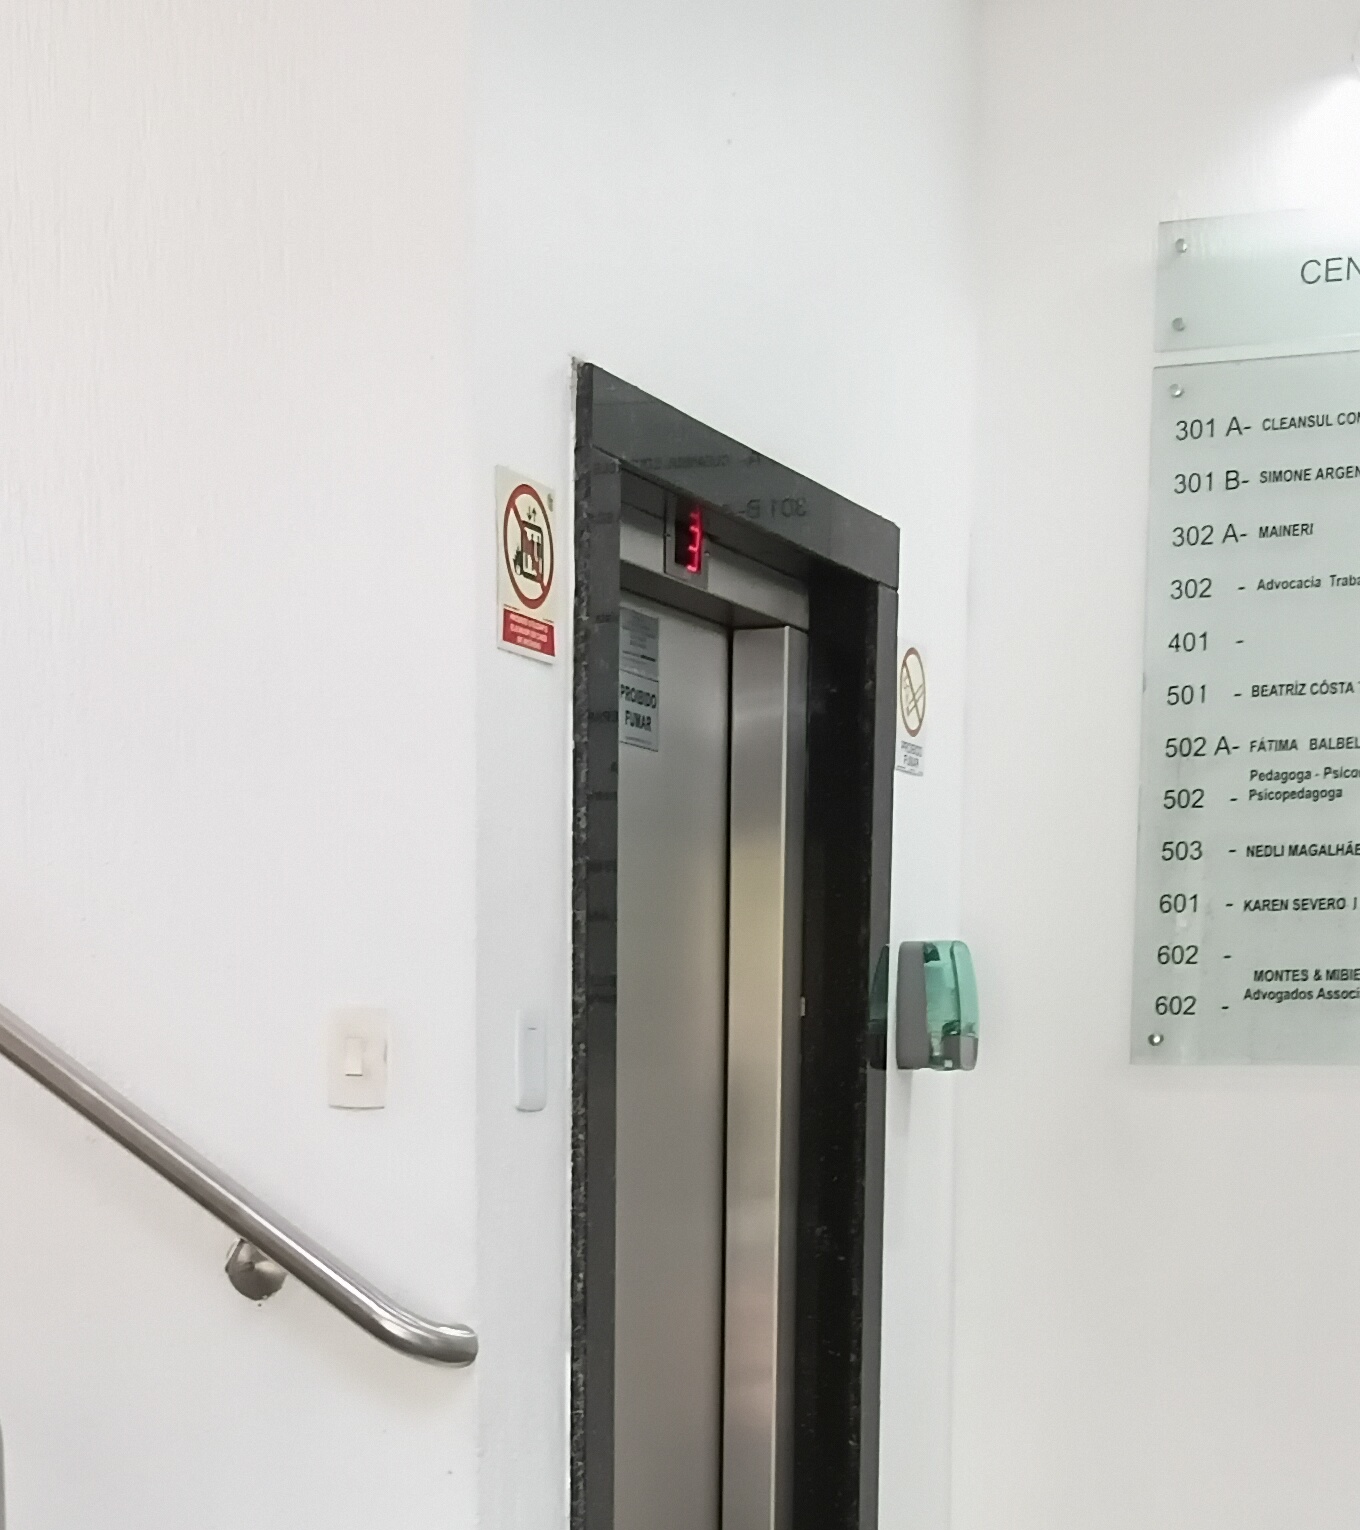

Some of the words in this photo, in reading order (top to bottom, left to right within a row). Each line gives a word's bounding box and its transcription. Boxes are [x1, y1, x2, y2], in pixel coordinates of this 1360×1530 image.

[1176, 418, 1214, 441] 301
[1262, 414, 1333, 431] CLEANSUL
[1174, 472, 1212, 494] 301
[1260, 468, 1312, 483] SIMONE
[1172, 525, 1213, 547] 302
[1259, 523, 1313, 538] MAINERI
[1170, 578, 1212, 600] 302
[1257, 576, 1321, 590] Advocacia
[1168, 631, 1207, 652] 401
[1167, 685, 1206, 705] 501
[1165, 737, 1206, 758] 502
[1250, 737, 1298, 752] FÁTIMA
[1250, 769, 1311, 784] Pedagoga
[1164, 789, 1204, 809] 502
[1249, 787, 1343, 802] Psicopedagoga
[1162, 841, 1203, 861] 503
[1246, 845, 1284, 857] NEDLI
[1159, 893, 1197, 913] 601
[1244, 899, 1289, 912] KAREN
[1293, 897, 1346, 911] SEVERO
[1157, 945, 1198, 965] 602
[1254, 969, 1309, 982] MONTES
[1313, 969, 1322, 981] &
[1155, 996, 1196, 1015] 602
[1243, 988, 1313, 1003] Advogados
